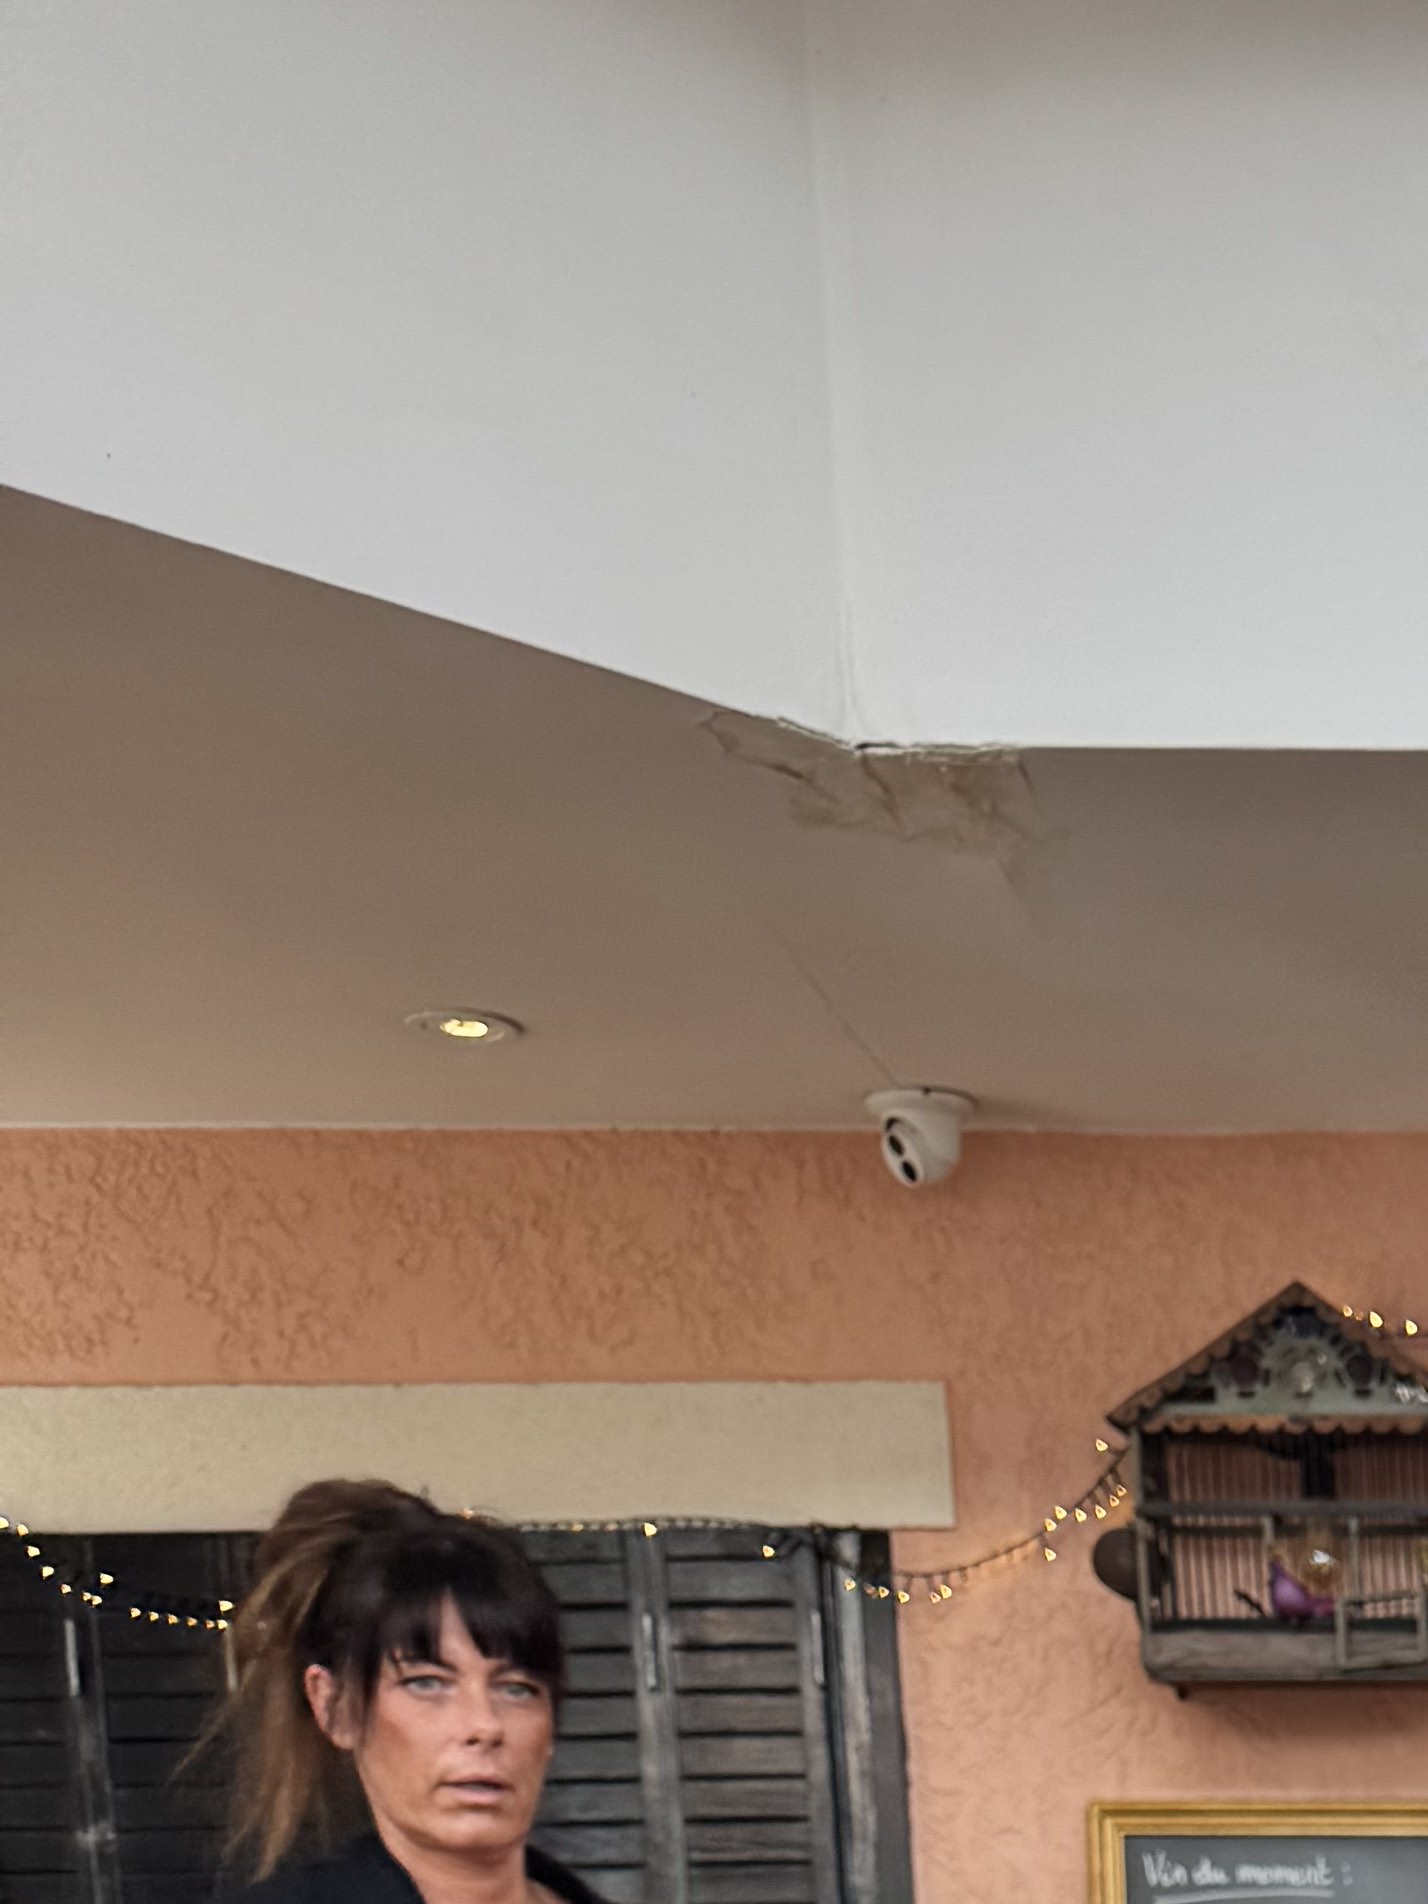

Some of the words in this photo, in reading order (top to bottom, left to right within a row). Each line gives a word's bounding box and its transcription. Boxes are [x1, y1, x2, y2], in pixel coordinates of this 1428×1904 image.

[1142, 1848, 1188, 1888] Vin
[1192, 1855, 1231, 1887] du
[1235, 1853, 1334, 1887] moment
